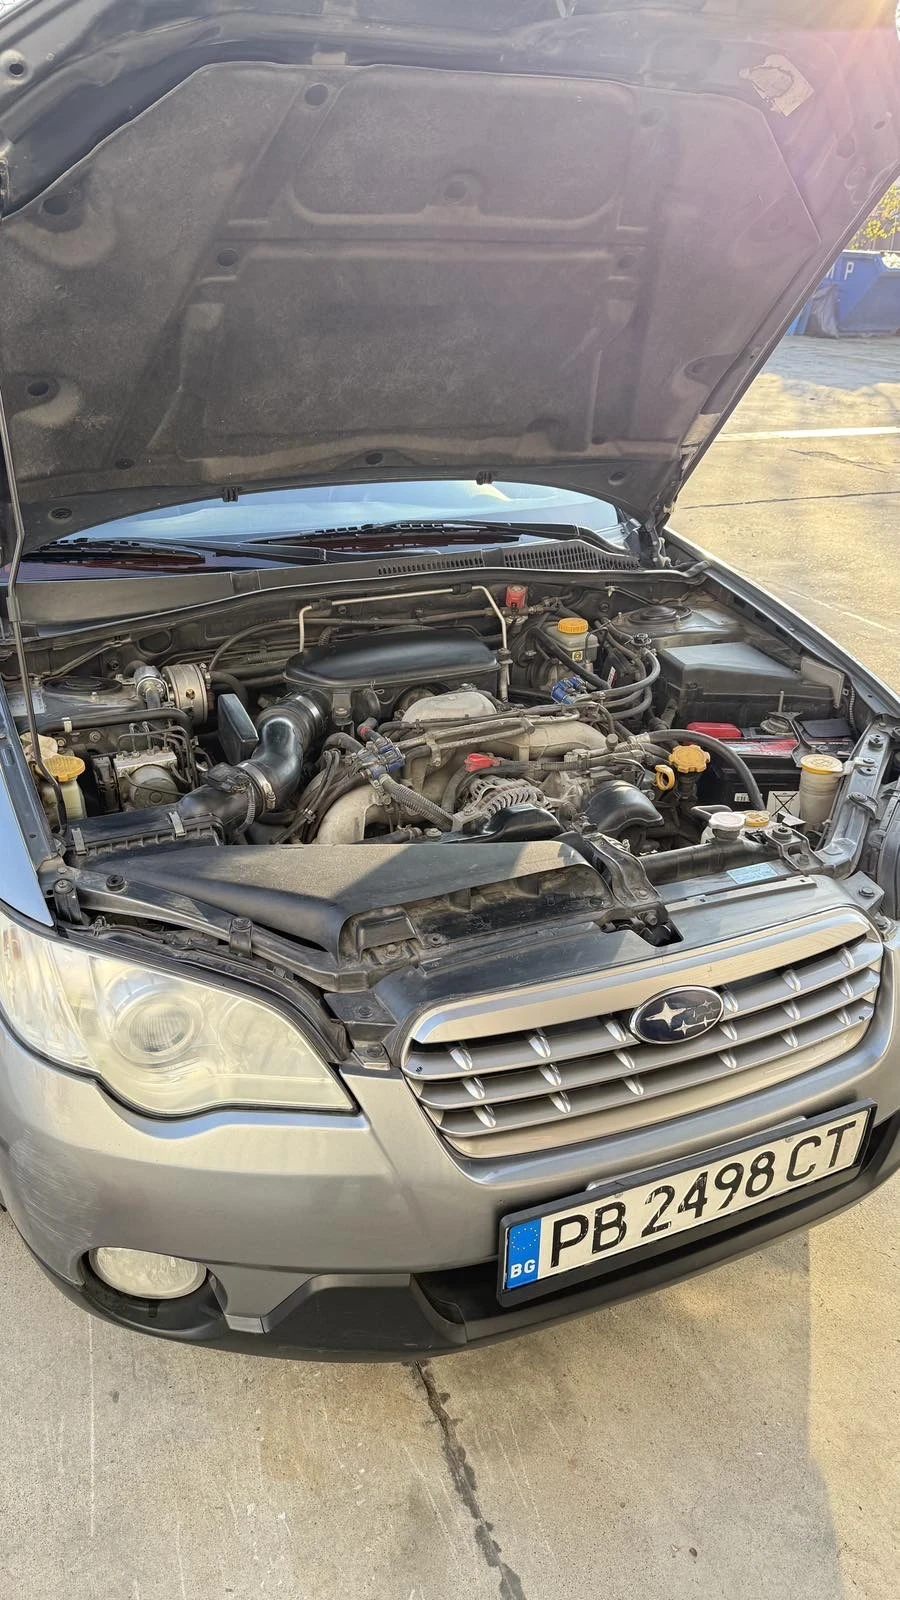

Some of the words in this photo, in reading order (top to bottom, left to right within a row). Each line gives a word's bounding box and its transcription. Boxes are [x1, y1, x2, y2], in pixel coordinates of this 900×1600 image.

[550, 1201, 626, 1268] PB
[641, 1151, 776, 1238] 2498
[785, 1120, 856, 1182] CT
[510, 1259, 536, 1279] BG
